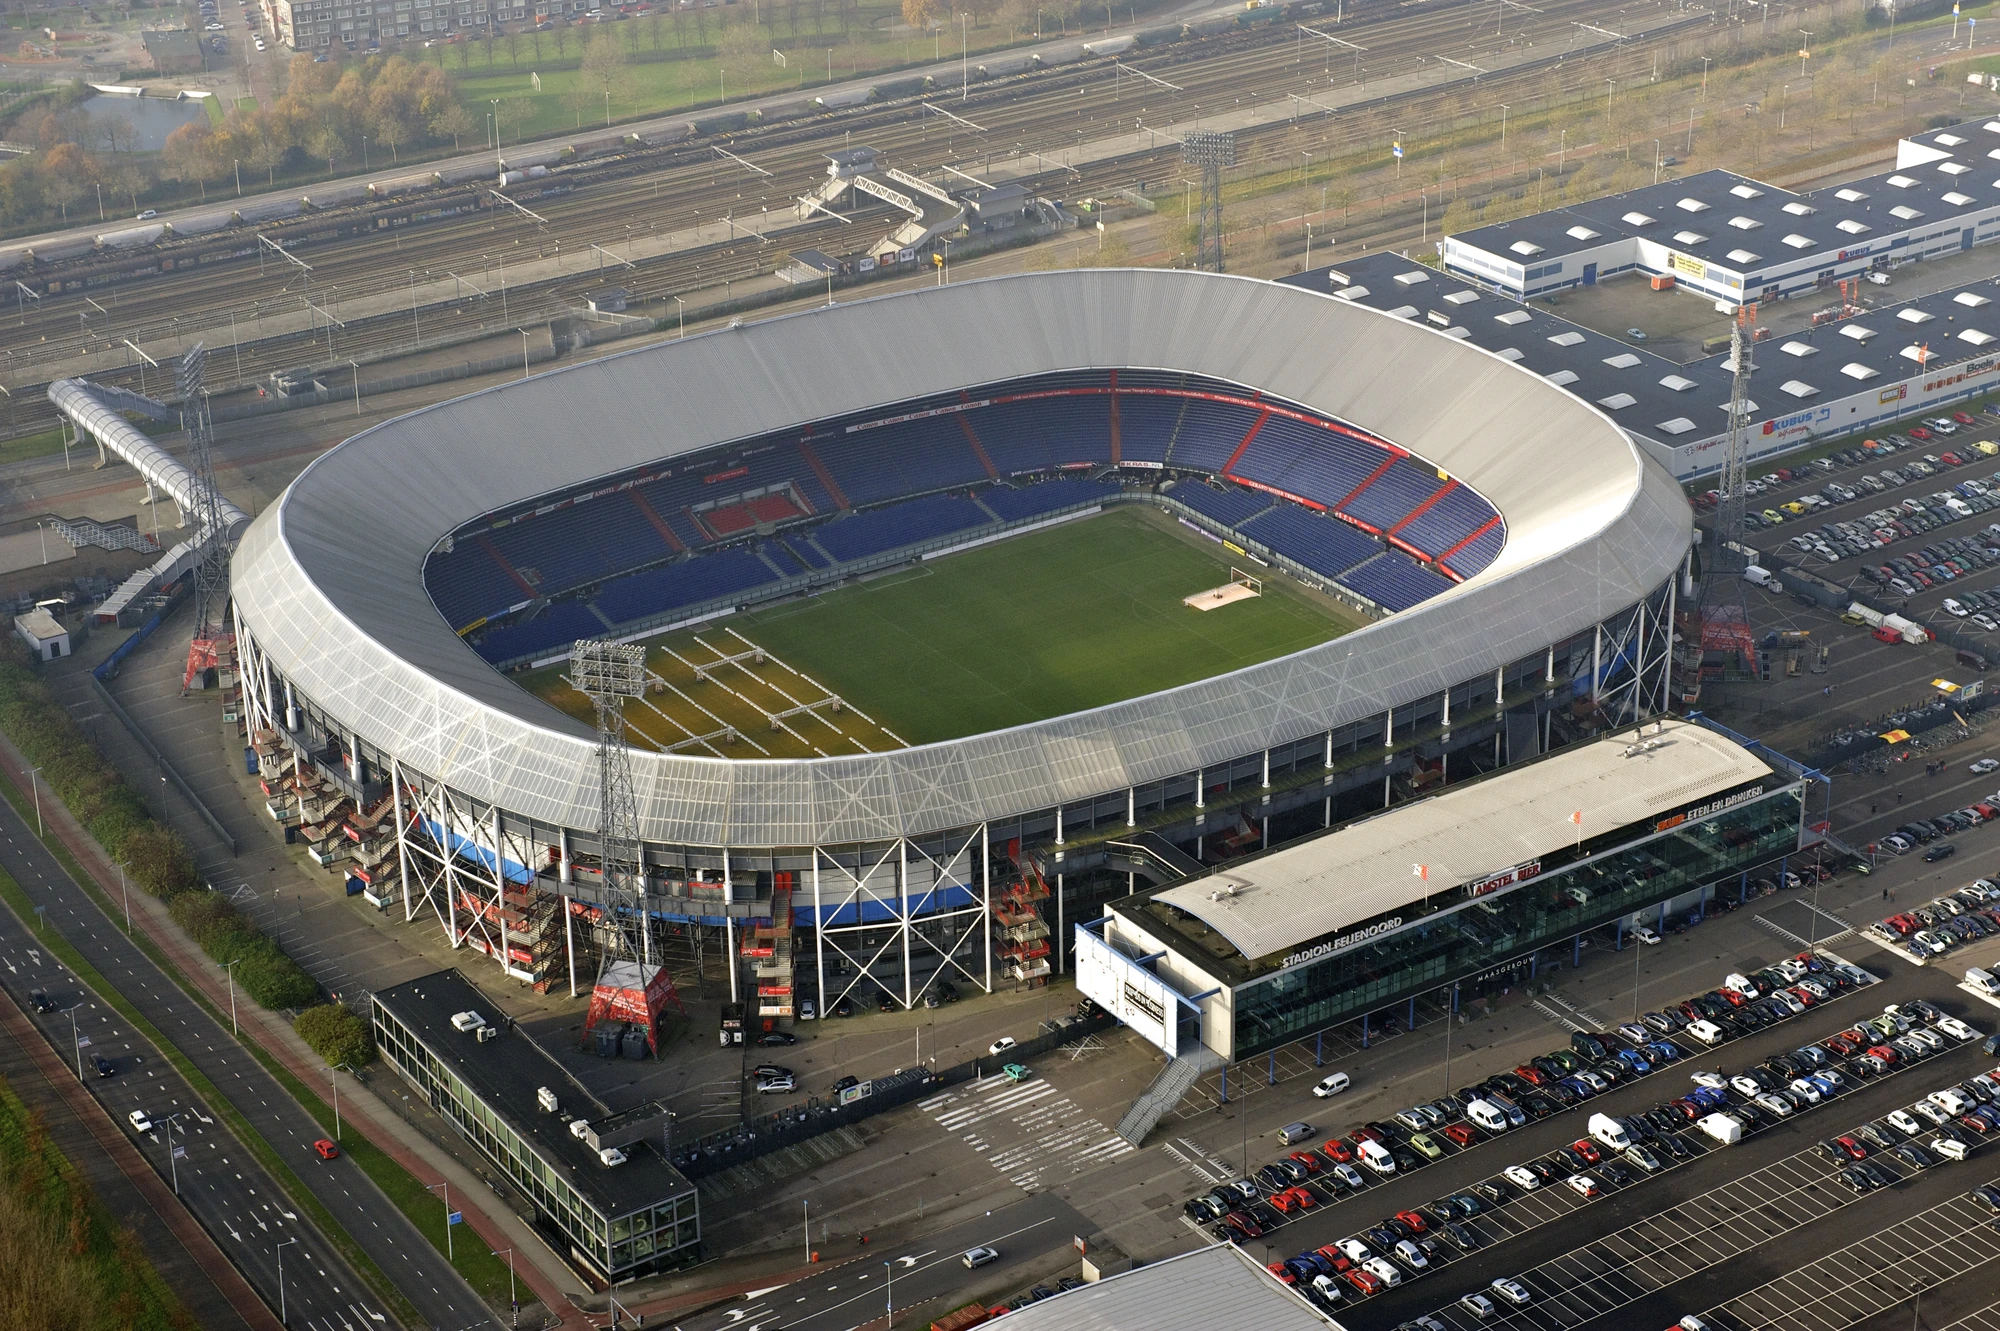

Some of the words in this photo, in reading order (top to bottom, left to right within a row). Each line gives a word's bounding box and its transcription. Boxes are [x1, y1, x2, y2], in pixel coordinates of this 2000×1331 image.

[1845, 246, 1871, 258] KUBUS
[1966, 359, 1994, 372] Boels
[856, 421, 878, 430] Canon
[883, 416, 904, 424] Canon
[909, 411, 930, 419] Canon
[935, 406, 956, 414] Canon
[1773, 412, 1813, 431] KUBUS
[594, 487, 615, 497] AMSTEL
[634, 476, 654, 486] AMSTEL
[1688, 804, 1710, 820] ETEN
[1712, 800, 1723, 812] EN
[1475, 874, 1514, 896] AMSTEL
[1518, 864, 1540, 880] BIER
[1282, 941, 1332, 969] STADION
[1334, 917, 1402, 950] FEIJENOORD
[1478, 956, 1536, 982] MAASGEBOUW
